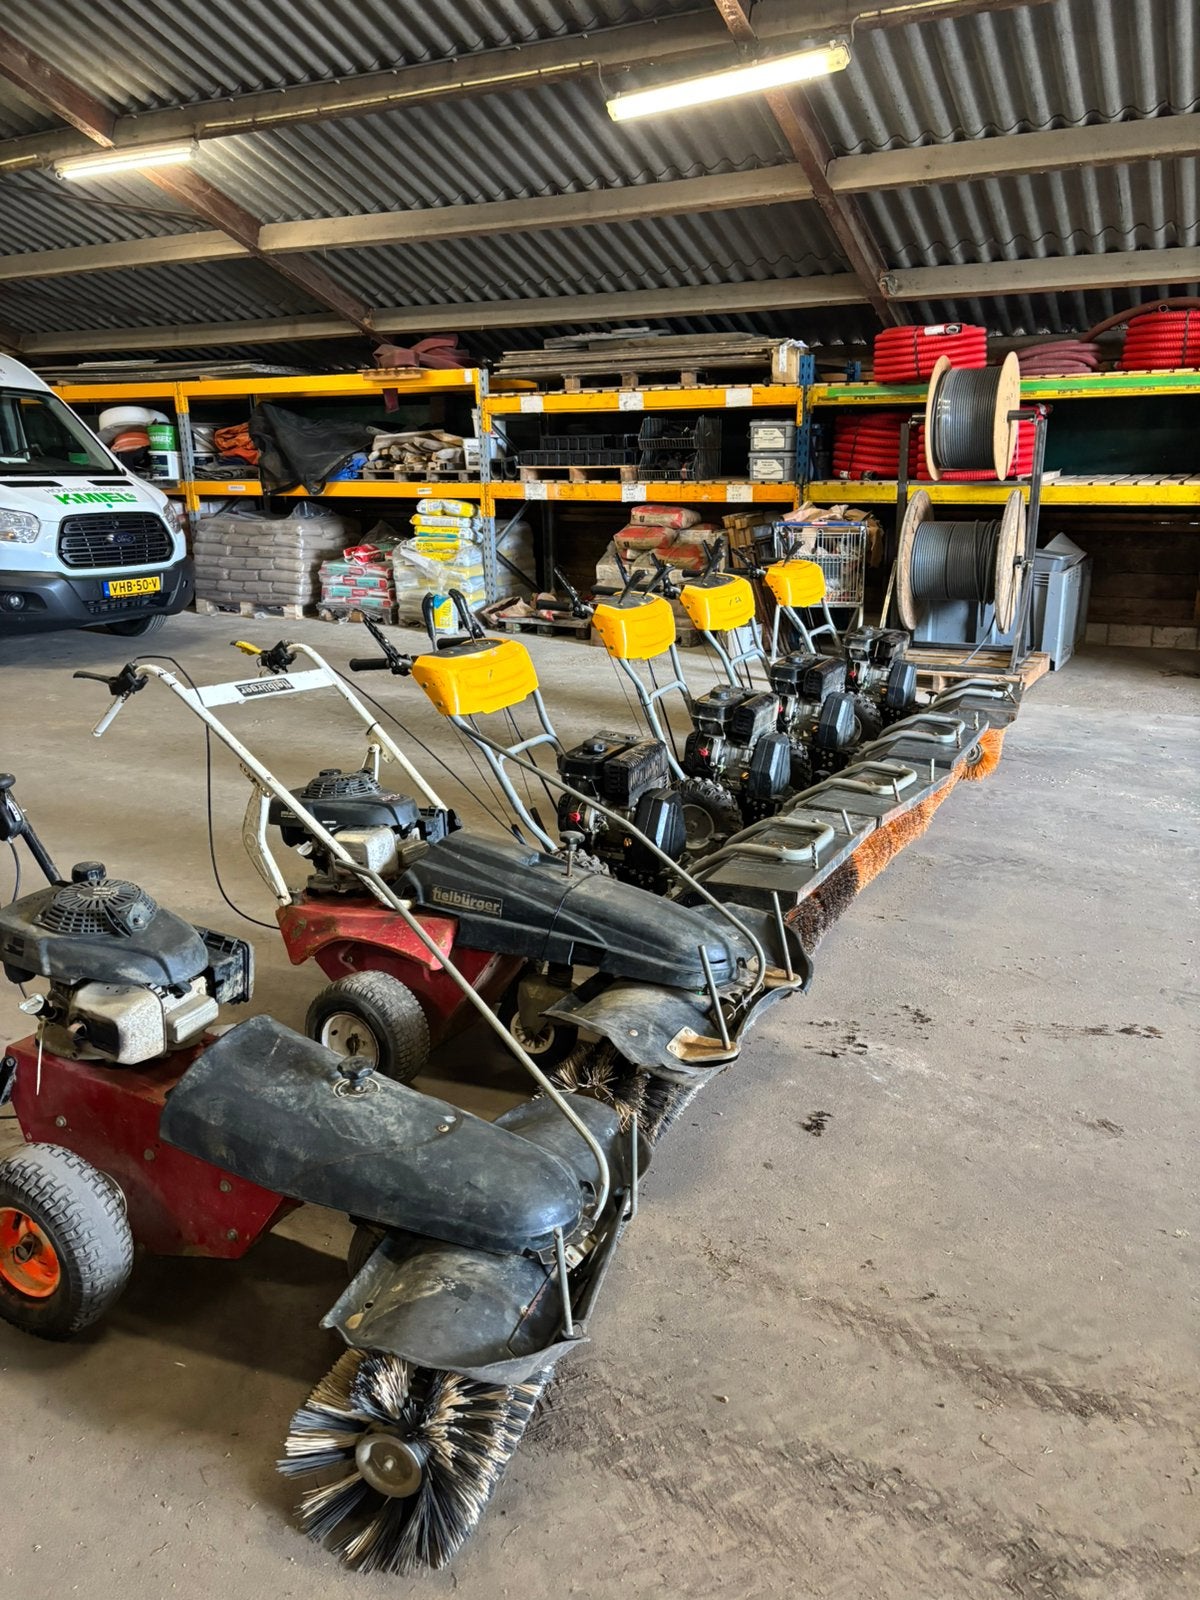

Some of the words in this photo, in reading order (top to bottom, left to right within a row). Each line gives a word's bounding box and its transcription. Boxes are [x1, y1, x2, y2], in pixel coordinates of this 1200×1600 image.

[53, 492, 138, 505] KMIEL
[111, 578, 158, 594] VHB-50-V
[431, 886, 502, 914] fielbürger
